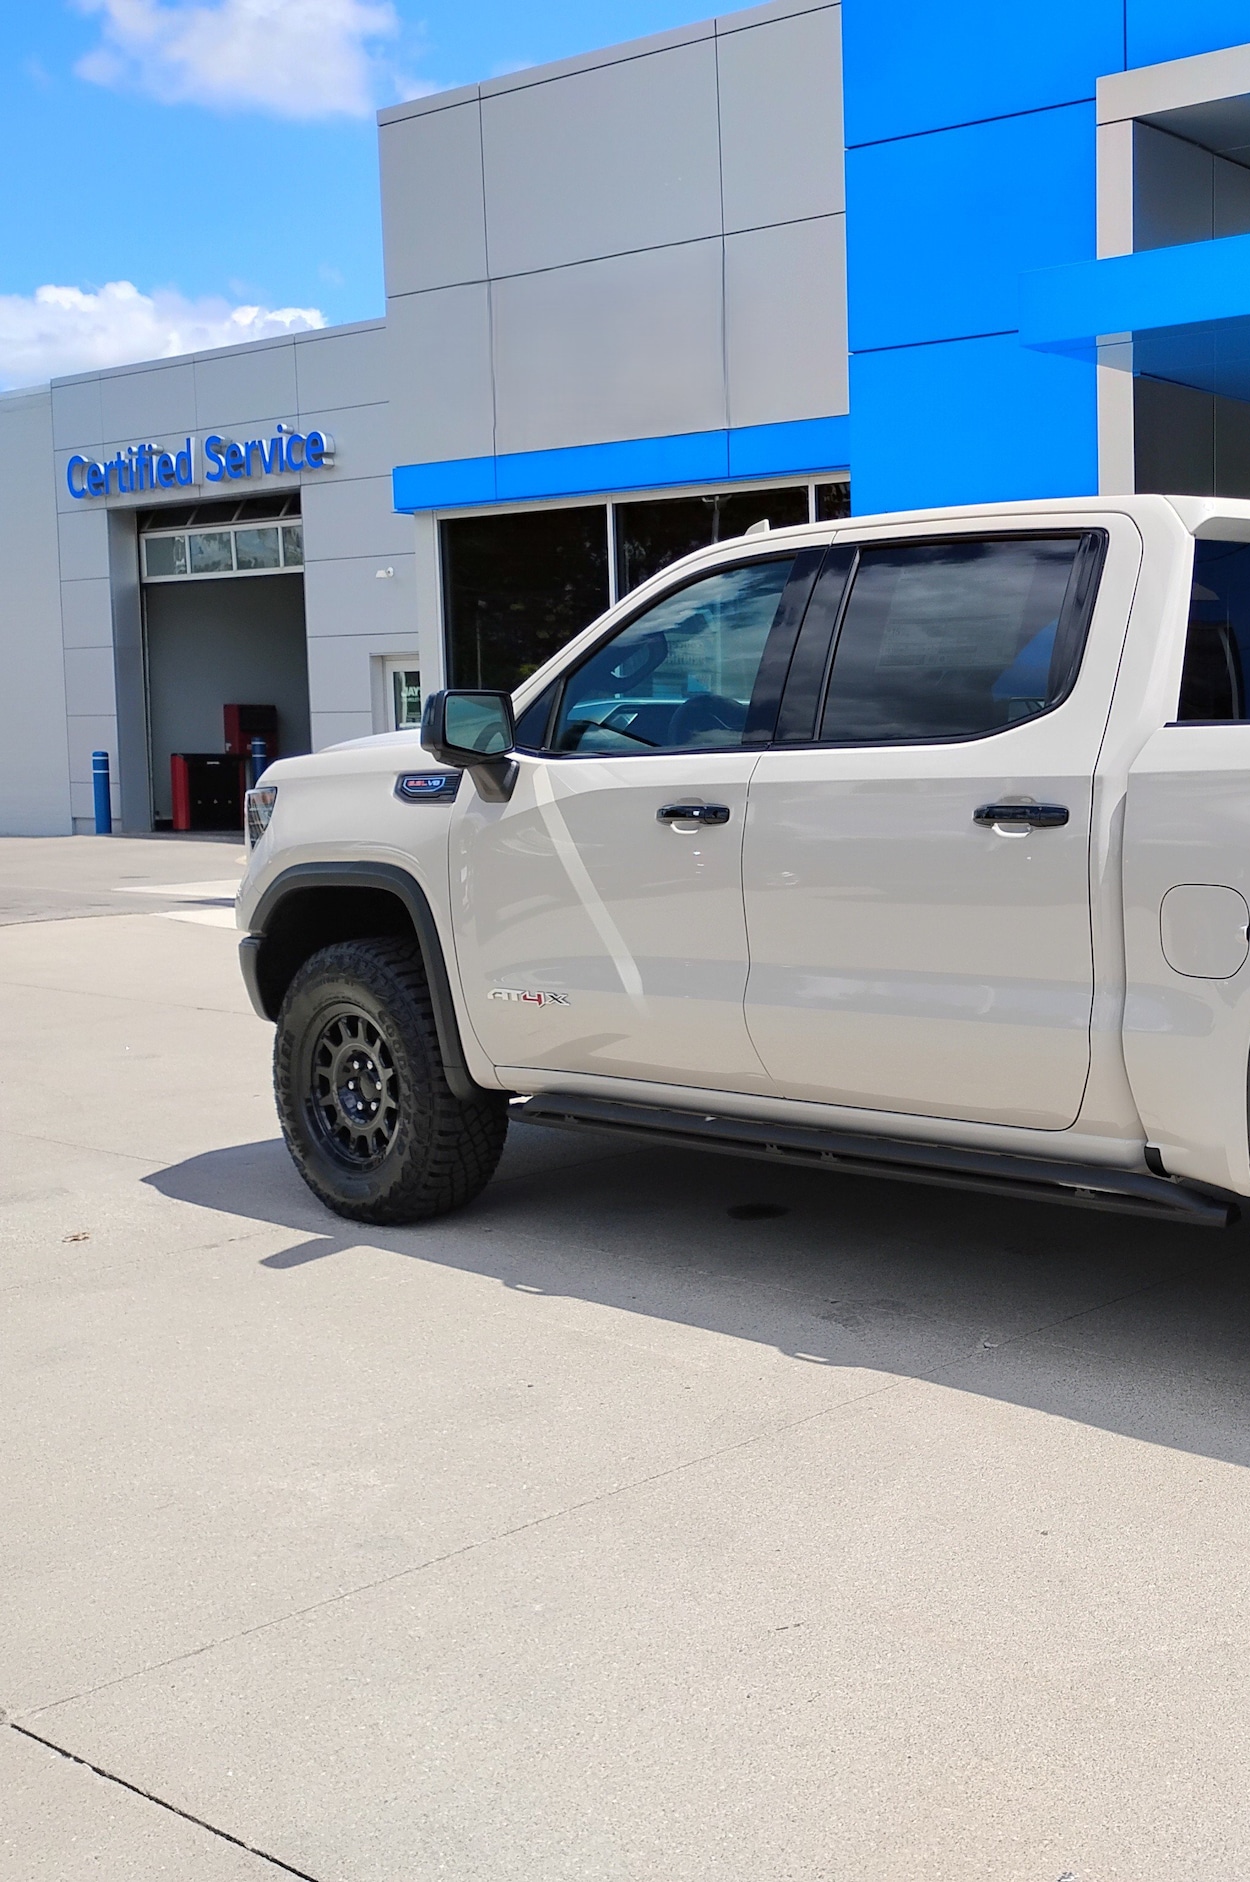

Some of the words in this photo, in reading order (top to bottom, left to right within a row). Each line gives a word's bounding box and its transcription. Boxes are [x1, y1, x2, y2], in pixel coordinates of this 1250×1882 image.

[66, 437, 196, 499] Certified
[204, 424, 328, 482] Service
[487, 987, 570, 1008] AT4X
